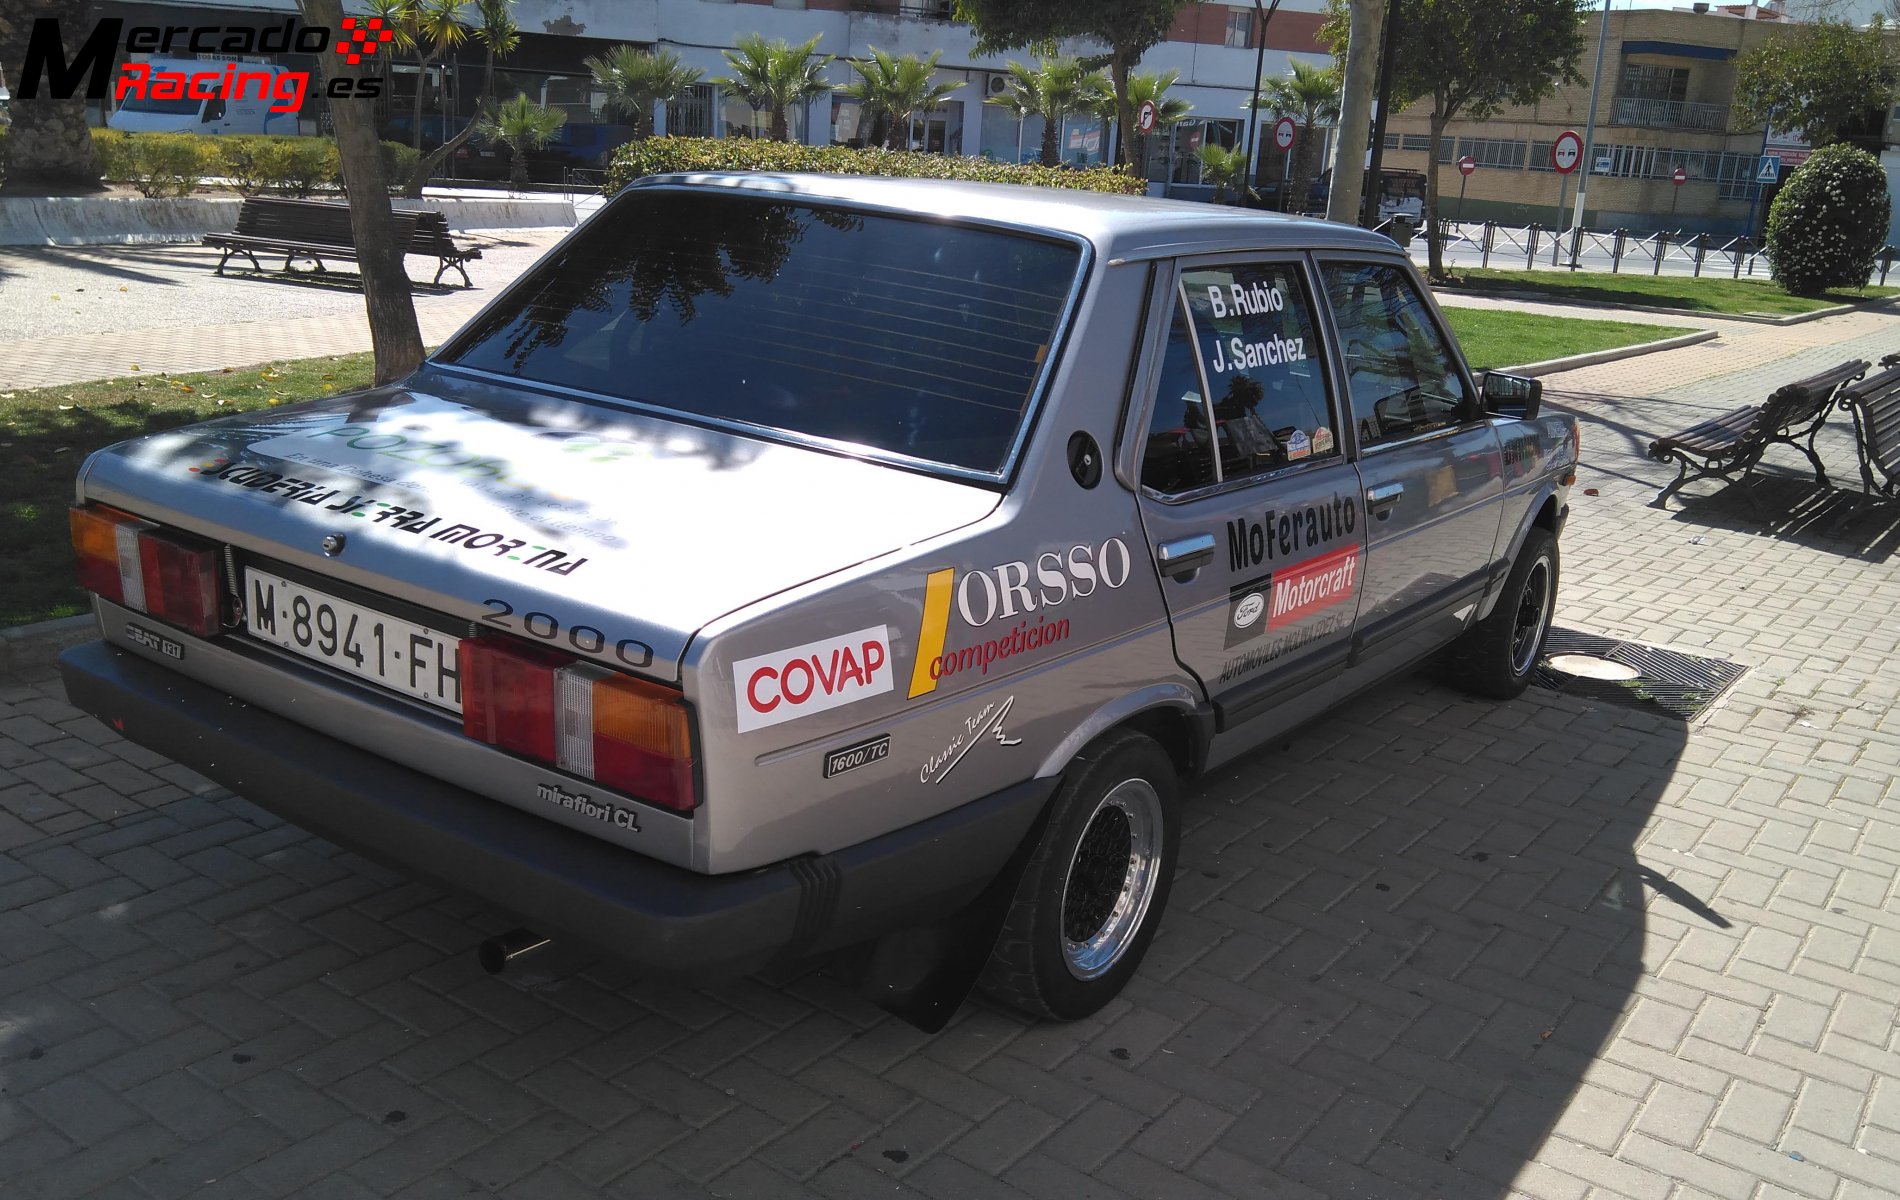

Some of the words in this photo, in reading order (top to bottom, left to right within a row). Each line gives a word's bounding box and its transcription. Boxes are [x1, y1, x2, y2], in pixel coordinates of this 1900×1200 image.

[1207, 281, 1284, 318] B.Rubio
[1213, 333, 1307, 372] J.Sanchez
[1226, 491, 1356, 573] MoFerauto
[957, 537, 1131, 629] ORSSO
[1237, 601, 1261, 621] Ford
[1272, 556, 1356, 618] Motorcraft
[126, 624, 160, 650] SEAT
[163, 641, 180, 657] 131
[481, 598, 654, 668] 2000
[929, 616, 1071, 681] competicion
[1219, 637, 1282, 685] AUTOMOVILES
[747, 640, 885, 714] COVAP
[830, 740, 889, 774] 1600/TC
[919, 735, 965, 785] Classic
[965, 701, 996, 734] Team
[536, 783, 611, 823] mirafiori
[613, 808, 641, 833] CL
